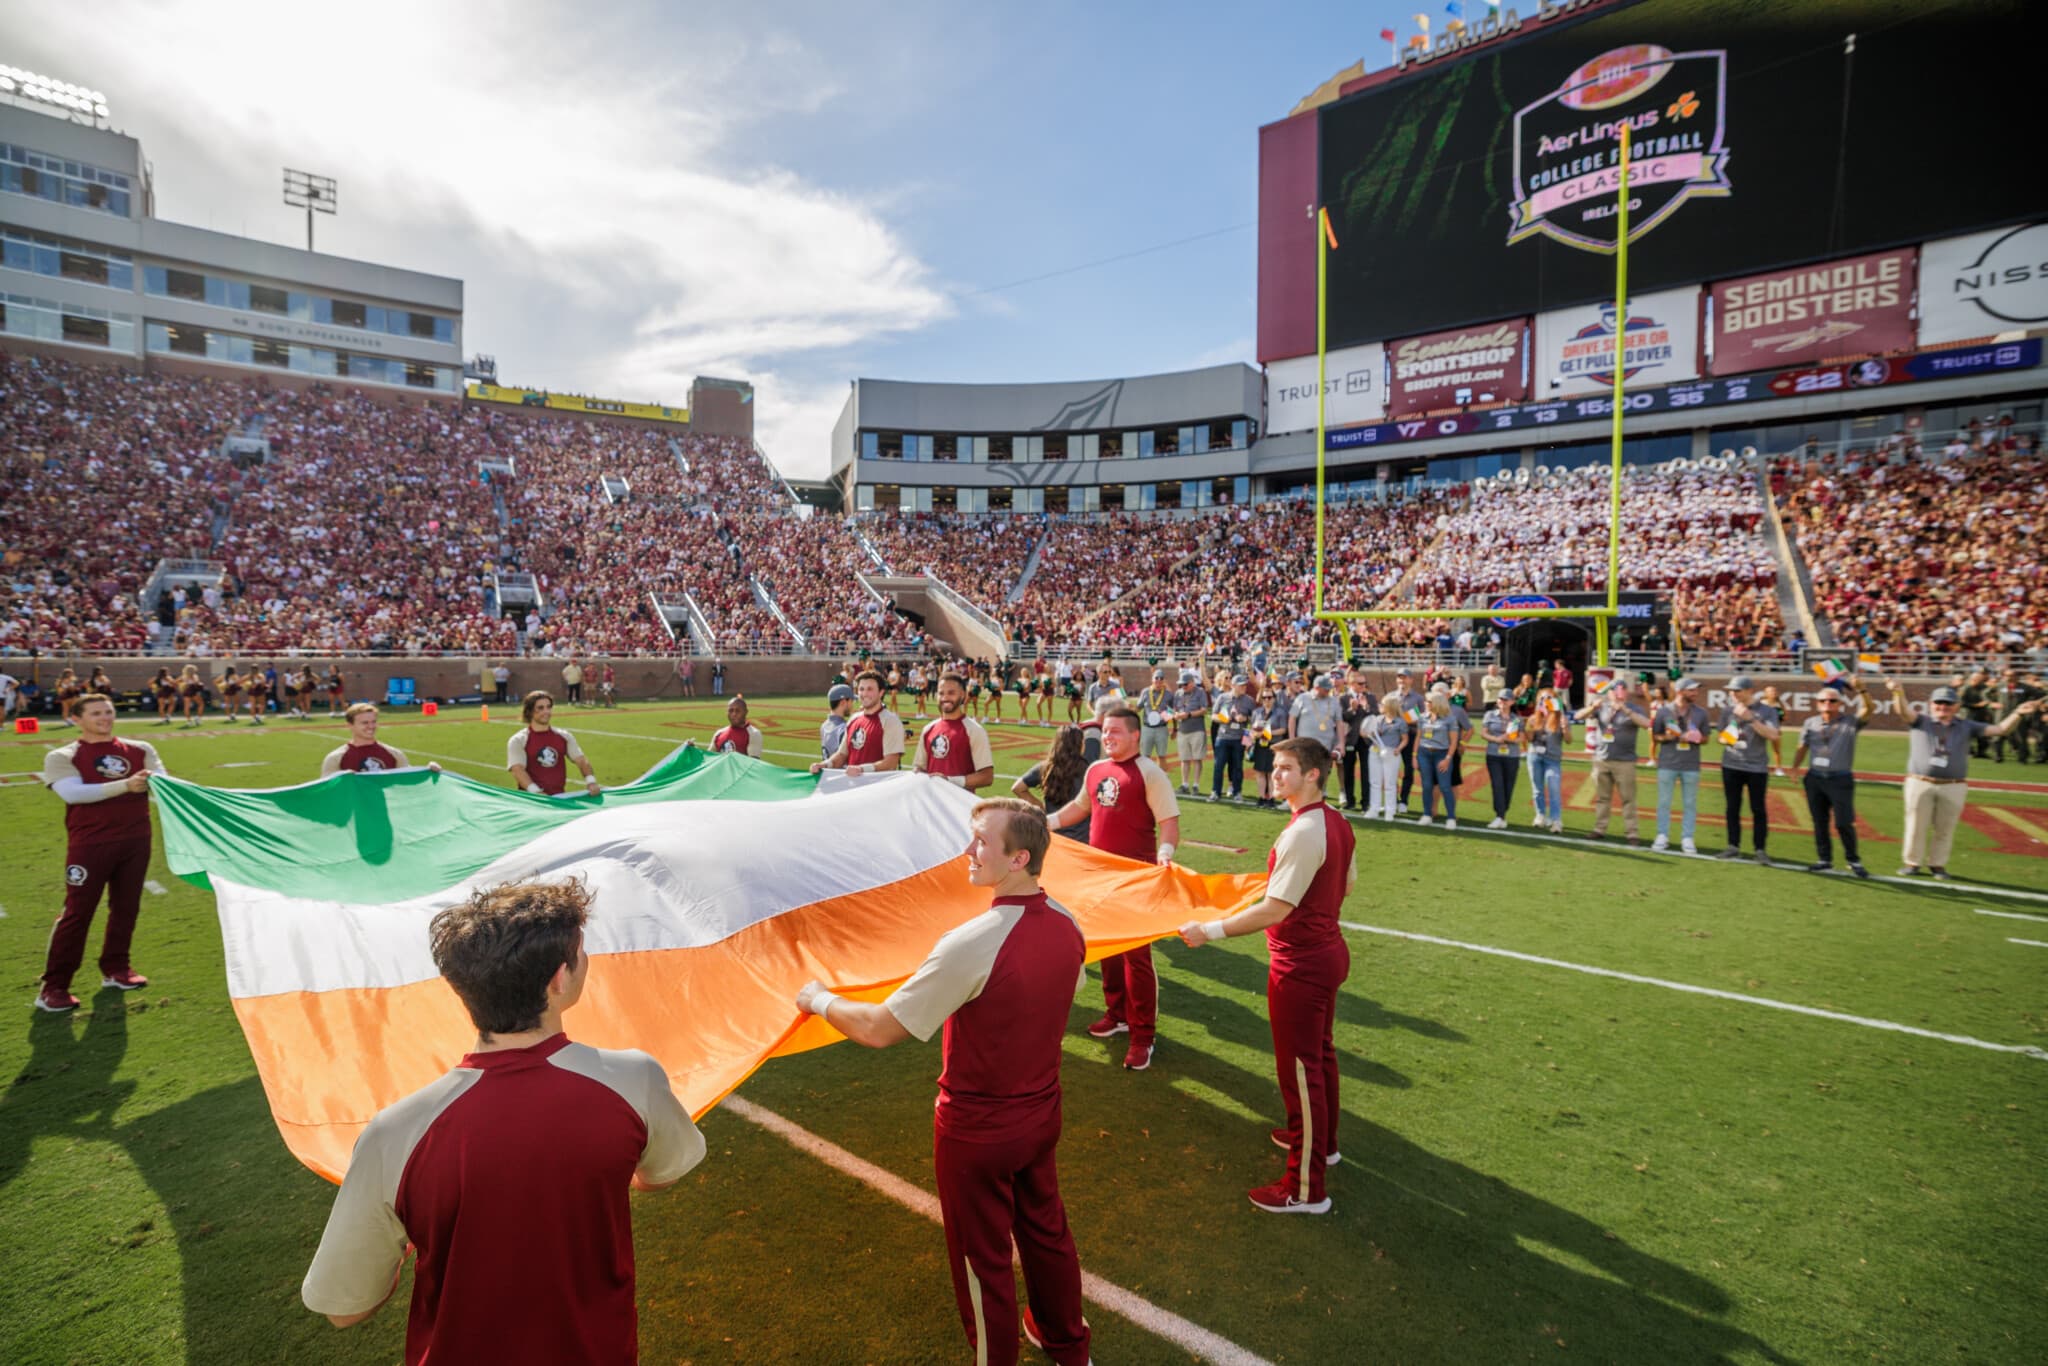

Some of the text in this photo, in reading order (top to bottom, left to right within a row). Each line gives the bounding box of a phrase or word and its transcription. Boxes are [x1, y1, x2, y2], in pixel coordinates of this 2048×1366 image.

[1399, 8, 1521, 71] FLORIDA
[1537, 110, 1660, 157] Aer Lingus
[1530, 132, 1703, 190] COLLEGE FOTBALL
[1562, 162, 1667, 200] CLASSIC
[1582, 198, 1642, 222] IRELAD
[1724, 258, 1901, 311] SEMINOLE
[1723, 284, 1900, 335] BOOSTERS
[1396, 325, 1519, 367] Seminole
[1562, 341, 1599, 359] DRIVE
[1650, 330, 1669, 345] OR
[1397, 347, 1516, 380] SPORTSHOP
[1560, 345, 1672, 373] GET PULLD OVER
[1932, 353, 1993, 370] TRUIST
[1278, 378, 1342, 402] TRUIST
[1728, 385, 1748, 400] 2
[1795, 372, 1843, 393] 22
[1670, 391, 1705, 407] 35
[1495, 415, 1512, 428] 2
[1535, 409, 1559, 423] 13
[1332, 431, 1363, 444] TRUIST
